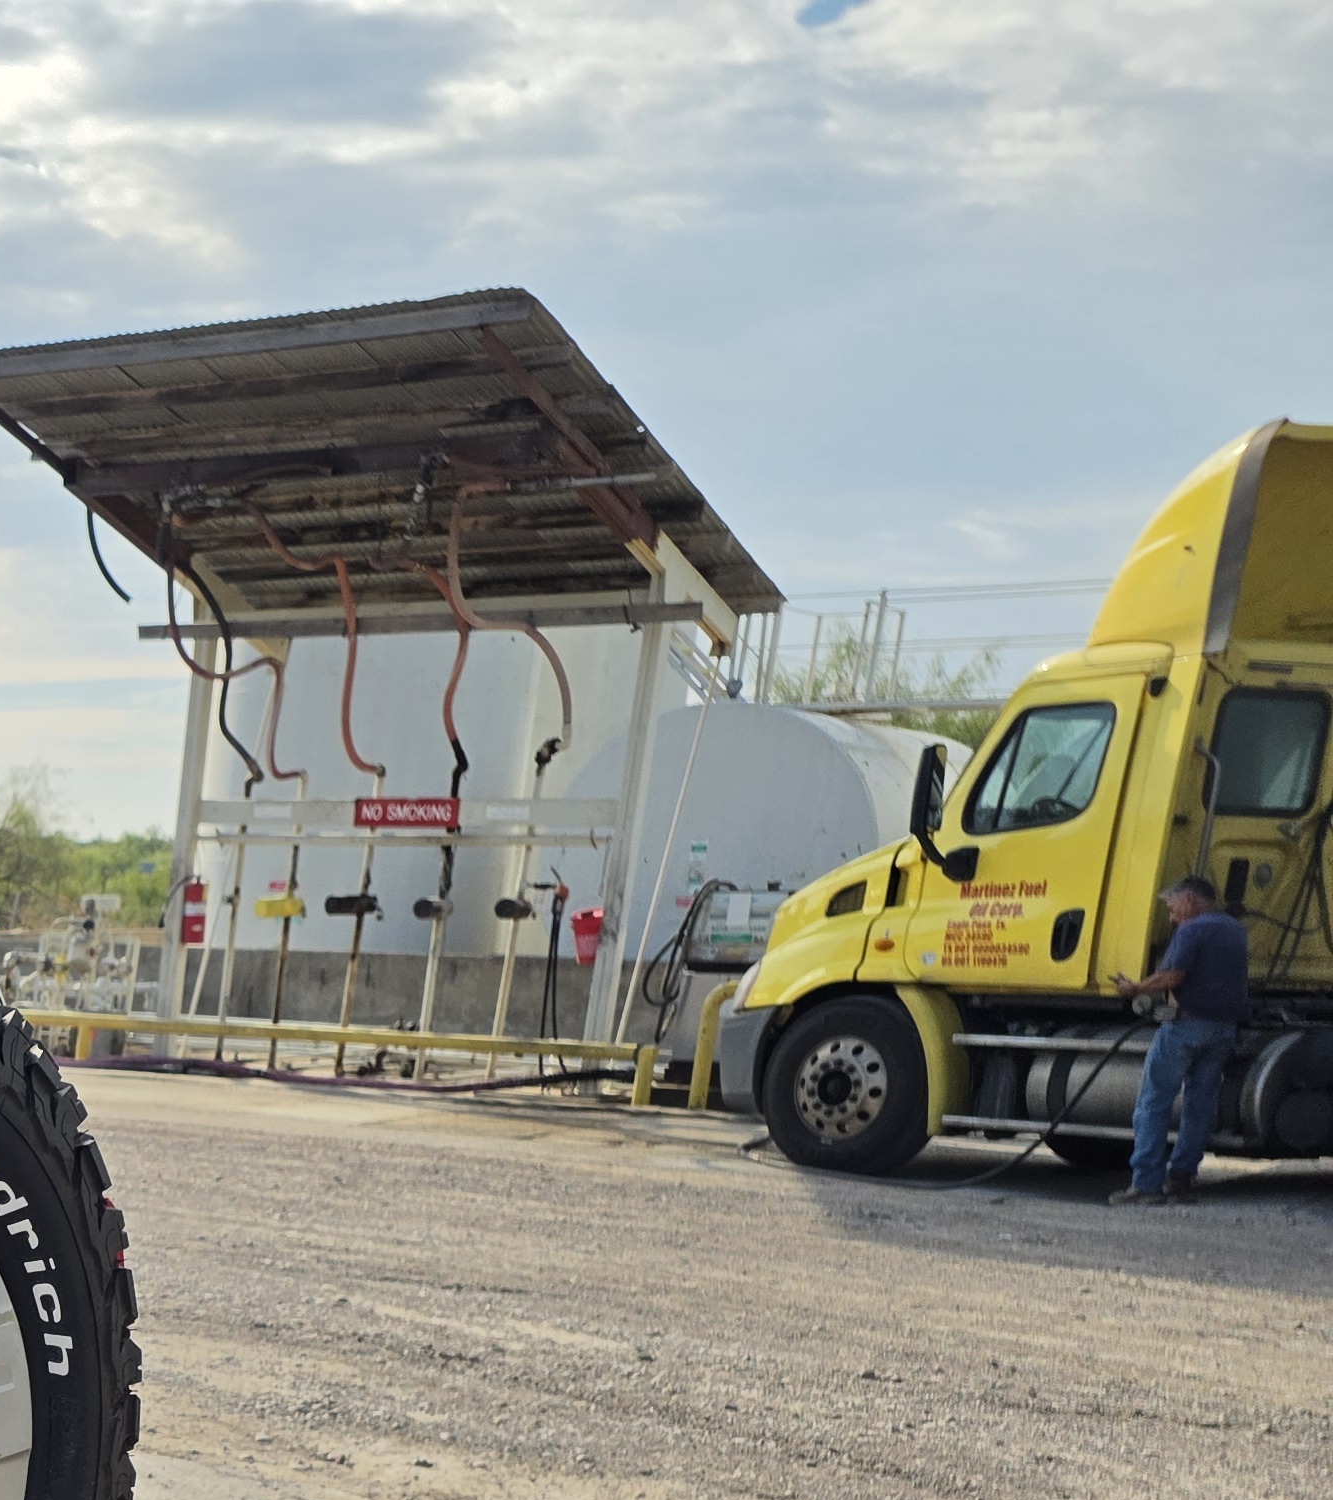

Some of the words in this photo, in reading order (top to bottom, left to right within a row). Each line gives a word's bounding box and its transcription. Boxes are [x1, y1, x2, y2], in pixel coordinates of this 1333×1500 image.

[361, 803, 383, 821] NO
[386, 803, 453, 822] SMOKING
[960, 881, 1017, 900] Martinez
[1018, 879, 1047, 898] Fuel
